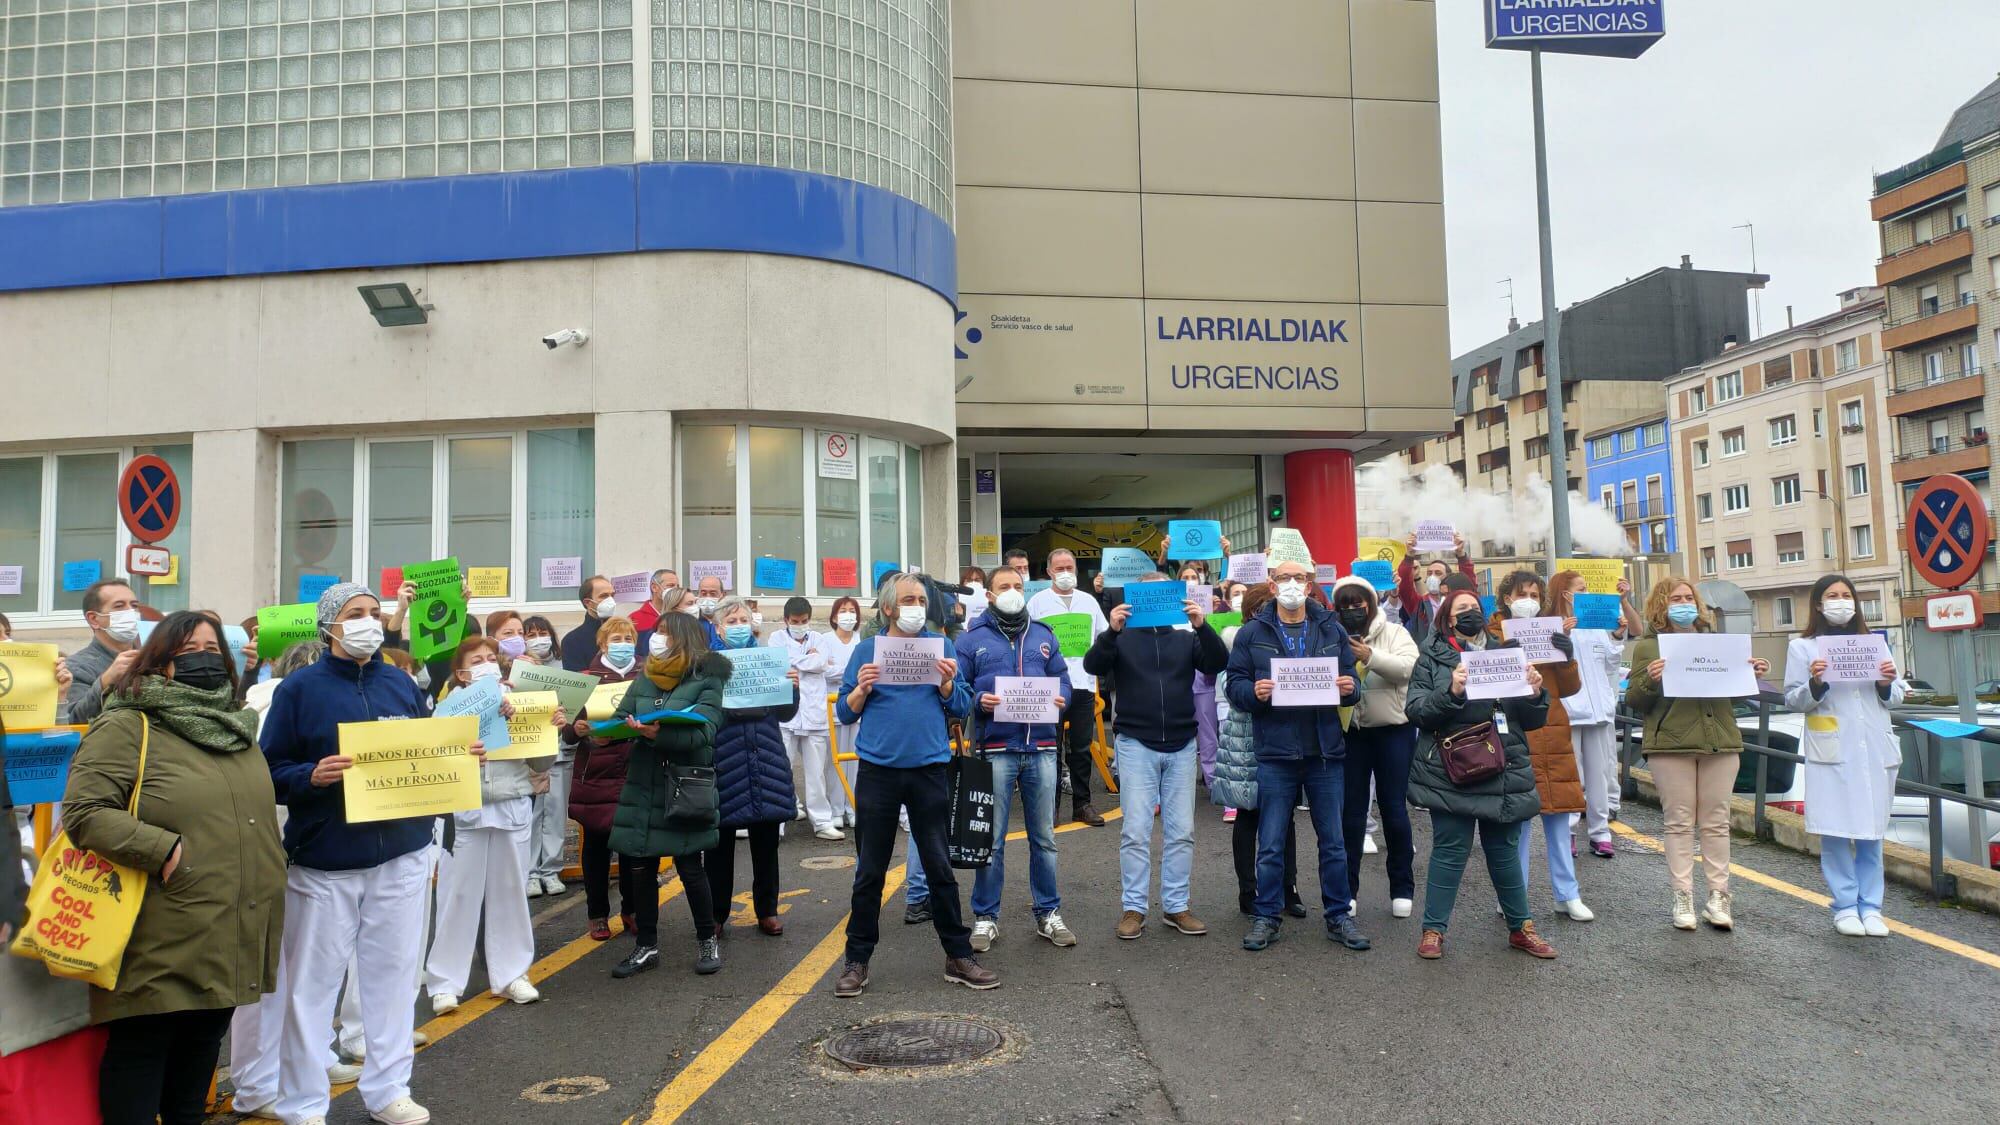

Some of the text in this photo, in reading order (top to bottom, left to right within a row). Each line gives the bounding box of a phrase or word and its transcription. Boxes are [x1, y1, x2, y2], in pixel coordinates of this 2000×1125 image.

[1511, 12, 1648, 34] URGENCIAS
[990, 314, 1031, 323] Osakidetza
[990, 322, 1019, 331] Servicio
[1043, 323, 1053, 331] de
[1054, 323, 1074, 332] salud
[1157, 316, 1349, 343] LARRIALDIAK
[1171, 365, 1339, 391] URGENCIAS
[882, 650, 936, 659] SANTIAGOKO
[1827, 646, 1878, 654] SANTIAGOKO
[731, 654, 771, 664] OSPITALES
[1493, 656, 1519, 665] CIERRE
[1480, 665, 1522, 674] URGENCIAS
[1832, 662, 1876, 671] ZERBITZUA
[1482, 673, 1521, 683] SANTIAGO
[1840, 671, 1869, 679] IXTEAN
[724, 677, 780, 689] RIVATIZACIÓN
[1292, 682, 1331, 690] SANTIAGO
[356, 744, 467, 763] MENOS RECORTES
[11, 767, 58, 779] SANTIAGO
[410, 762, 419, 772] Y
[365, 771, 461, 790] MÁS PERSONAL
[976, 806, 985, 818] &
[51, 847, 114, 883] CRYPT
[62, 873, 99, 894] RECORDS
[50, 886, 95, 920] COOL
[53, 910, 82, 928] AND
[36, 917, 91, 951] CRAZY
[62, 956, 99, 970] HAMBURG
